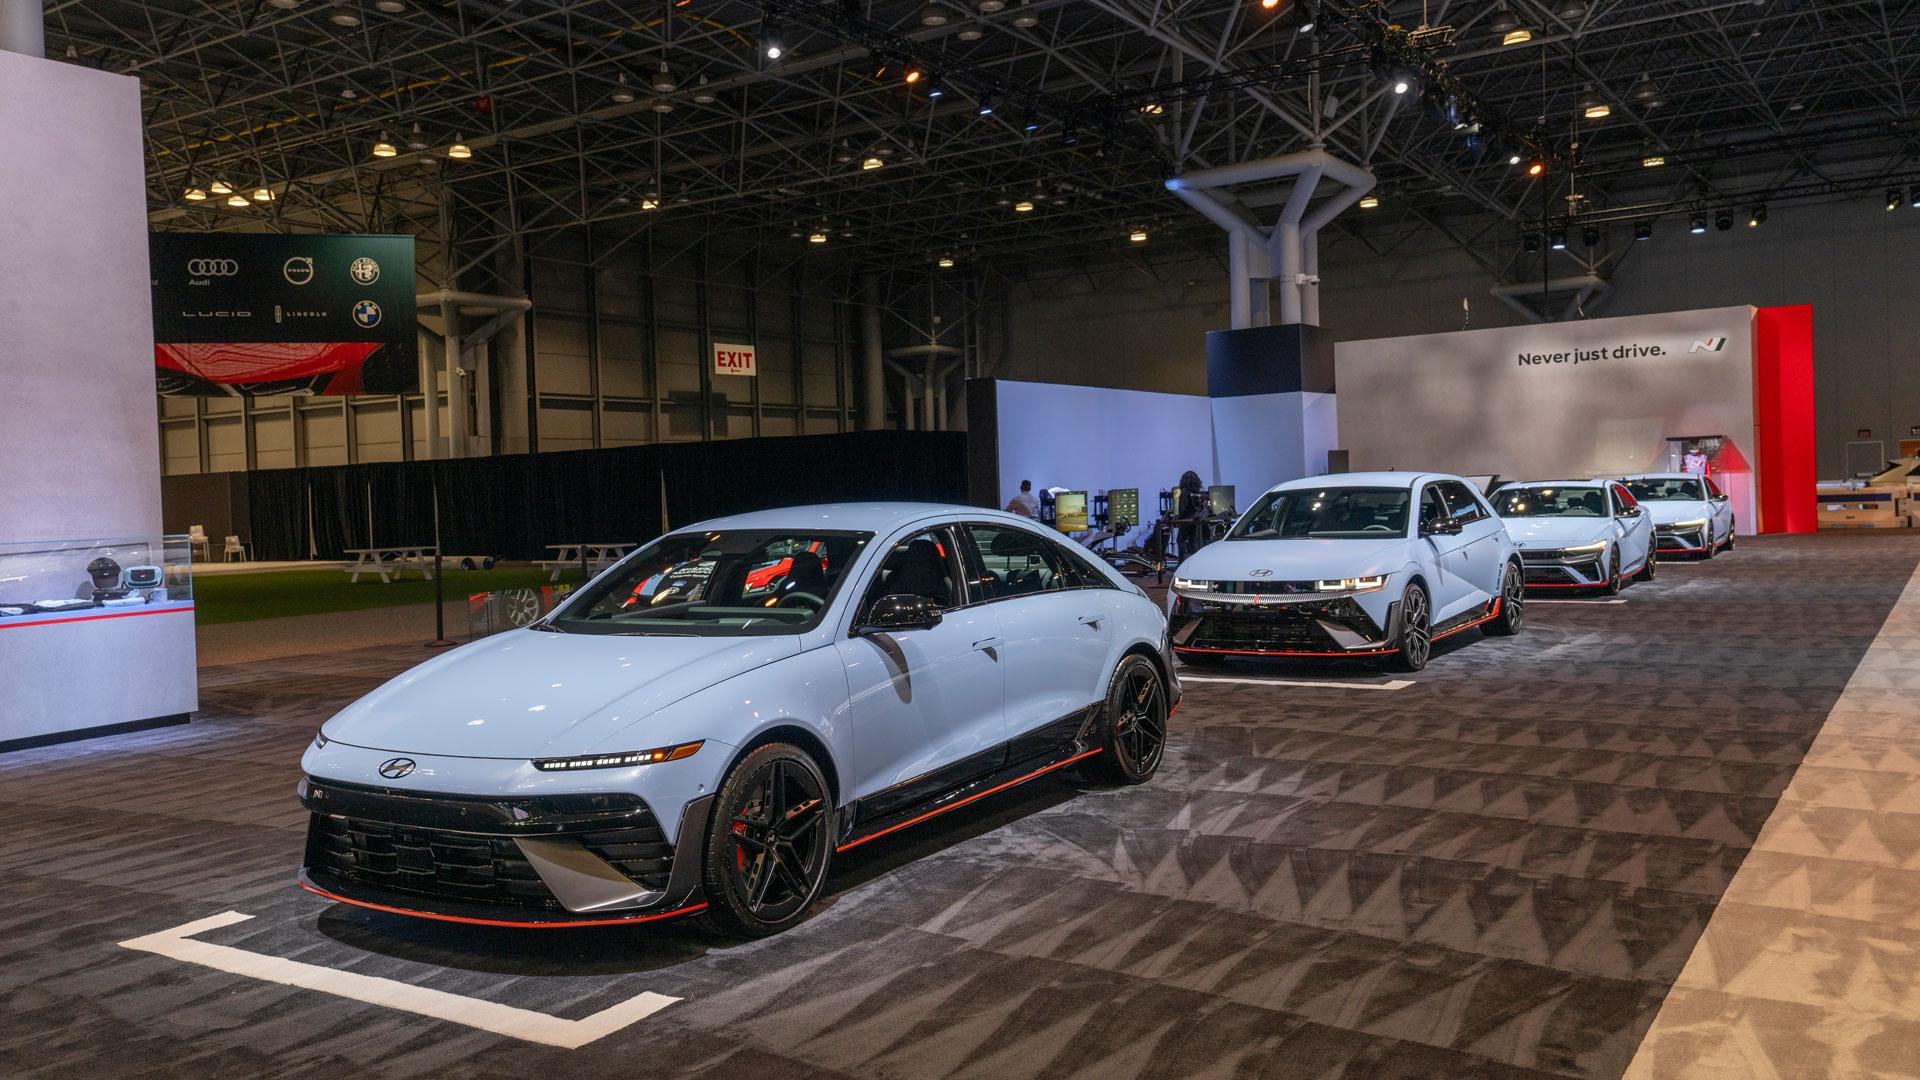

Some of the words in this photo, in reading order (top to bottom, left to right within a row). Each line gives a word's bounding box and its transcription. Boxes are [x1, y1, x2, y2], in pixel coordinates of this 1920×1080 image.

[717, 351, 752, 368] EXIT
[1518, 351, 1571, 366] Never
[1573, 347, 1608, 364] just
[1612, 344, 1667, 359] drive.
